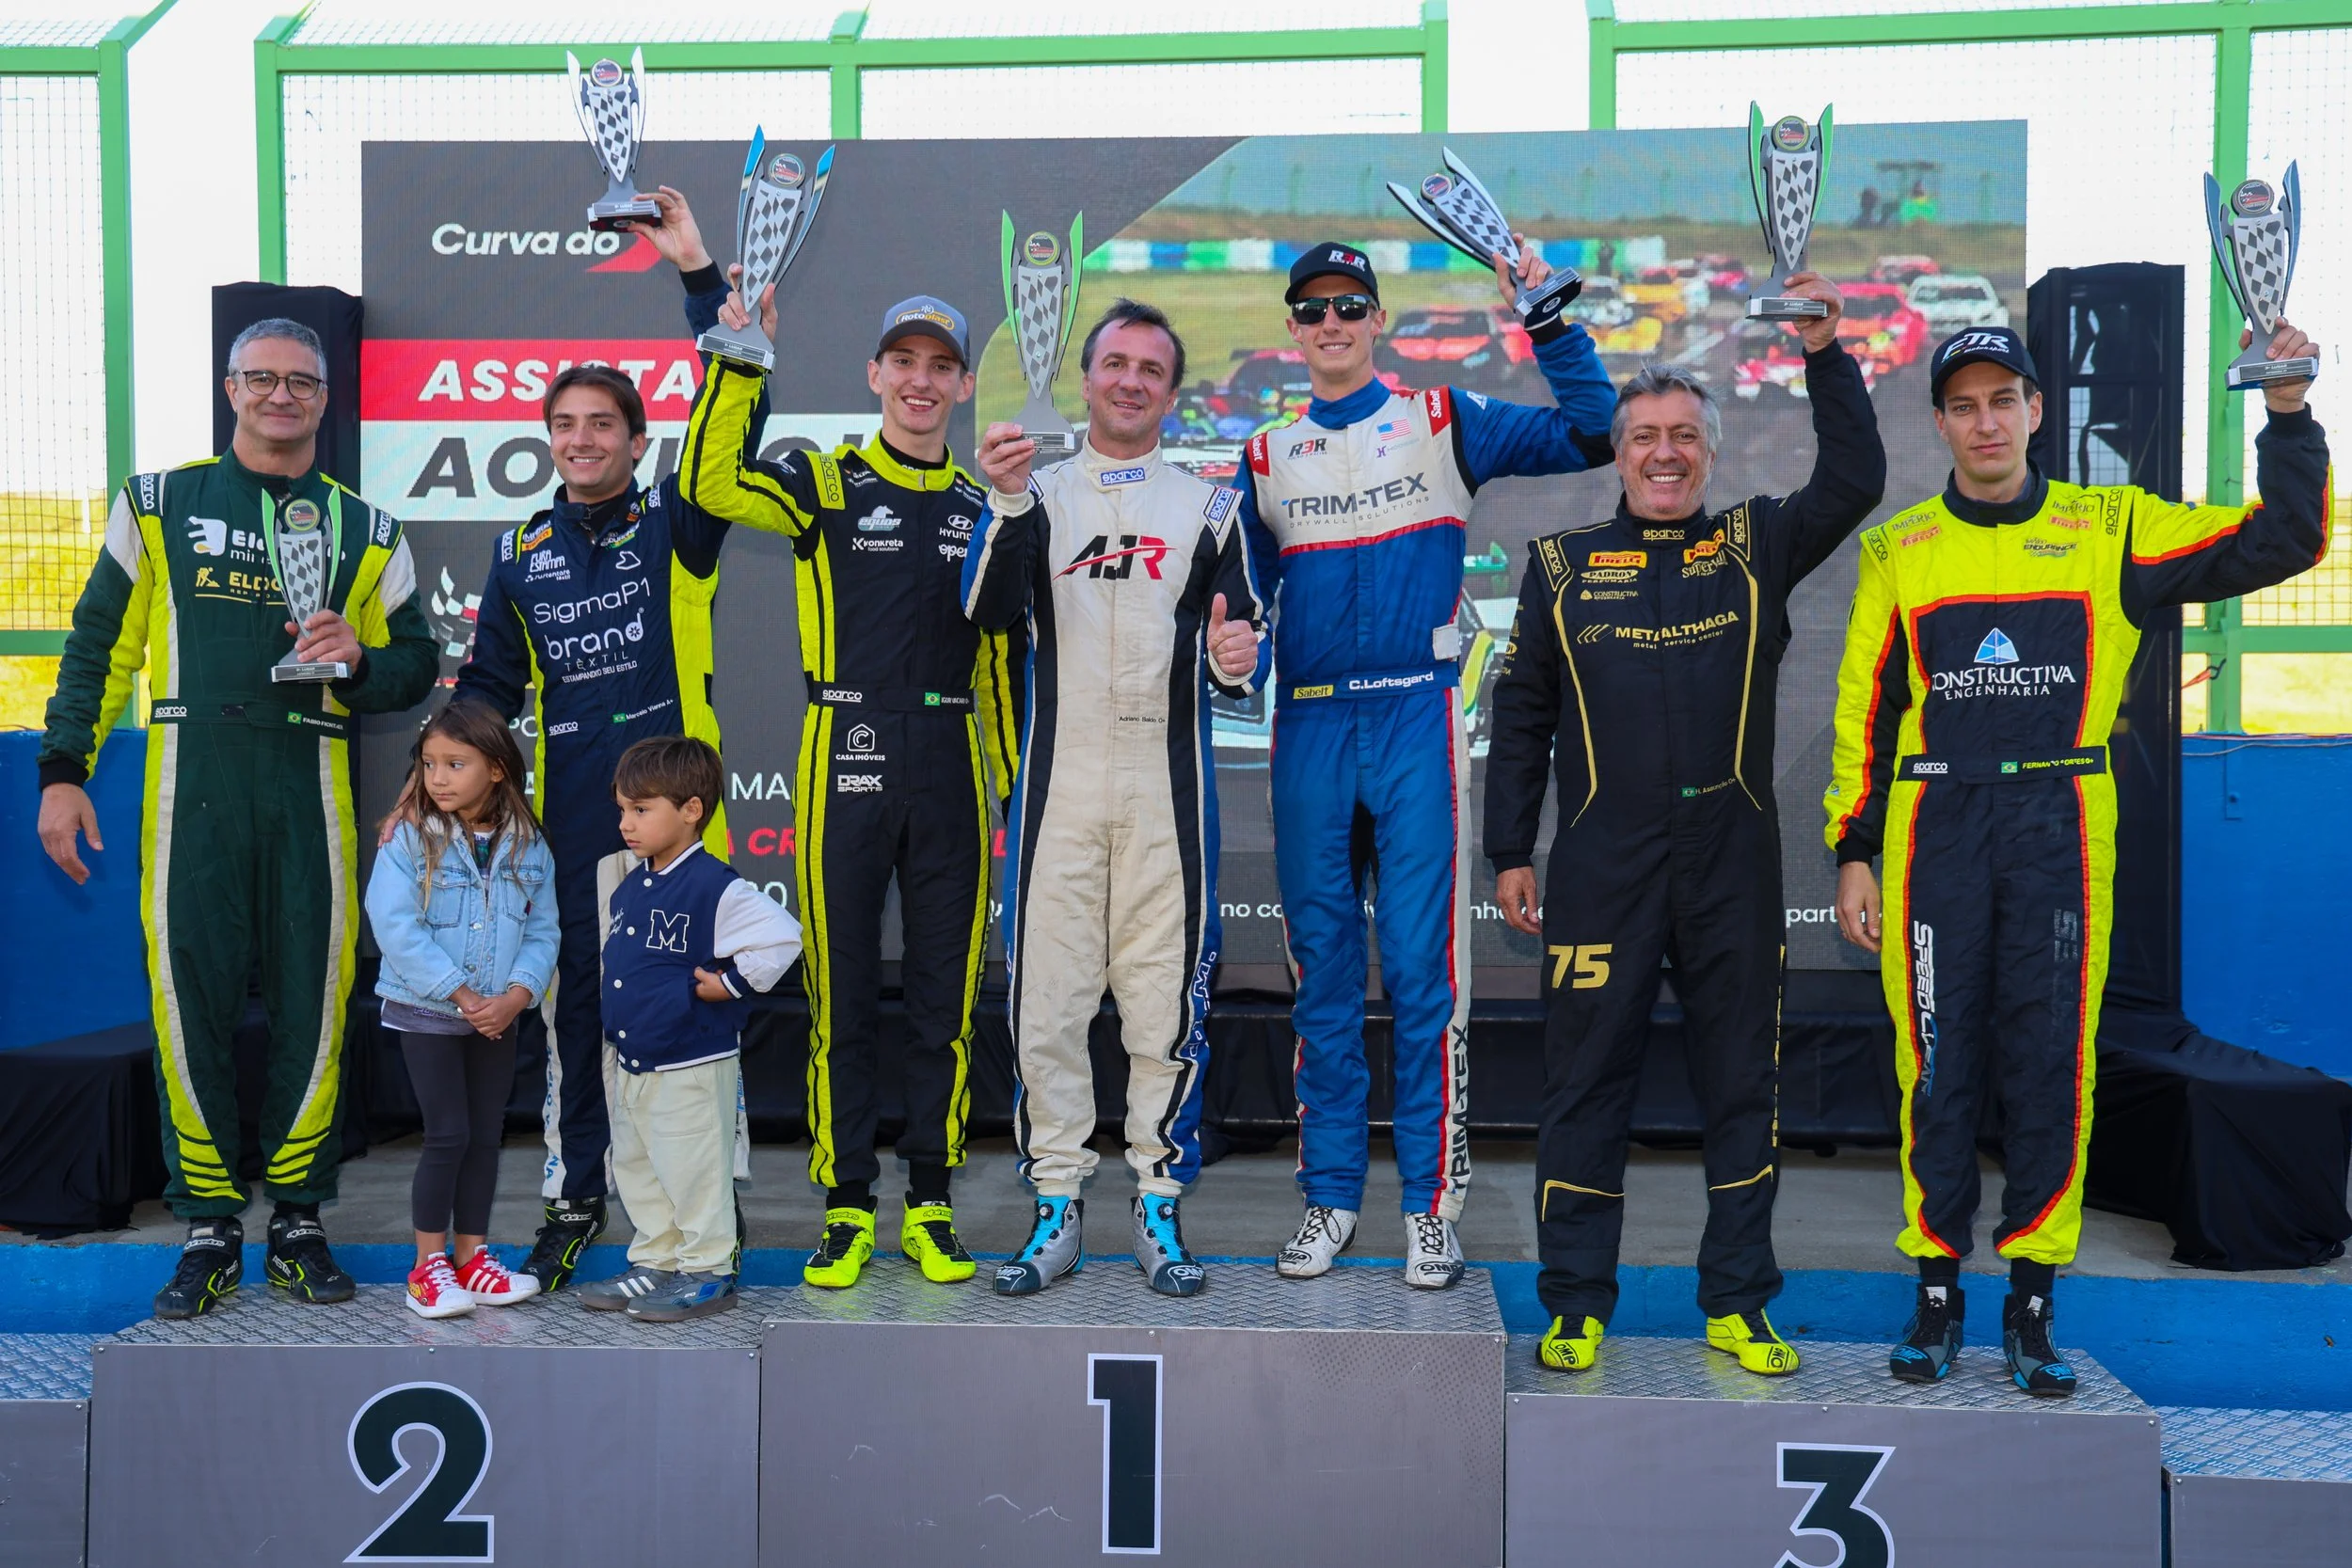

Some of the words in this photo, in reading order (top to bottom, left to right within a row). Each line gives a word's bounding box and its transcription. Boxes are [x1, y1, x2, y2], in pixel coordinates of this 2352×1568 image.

[431, 222, 559, 256] Curva
[564, 230, 620, 256] do
[418, 359, 697, 402] ASSTA
[1288, 437, 1327, 458] R3R
[1102, 468, 1145, 485] sparco
[1280, 471, 1428, 518] TRIM-TEX
[939, 527, 973, 542] HYUND
[1642, 528, 1686, 541] sparco
[1063, 534, 1168, 580] AJR
[1542, 538, 1564, 575] sparco
[533, 577, 651, 624] SigmaP1
[544, 612, 644, 660] brand
[602, 664, 616, 675] SEU
[616, 660, 638, 673] ESTILO
[822, 689, 863, 703] sparco
[1296, 686, 1329, 698] Sabelt
[1348, 671, 1435, 690] C.Loftsgard
[1944, 684, 2051, 701] ENGENHARIA
[155, 706, 187, 718] sparco
[548, 721, 579, 736] sparco
[854, 752, 886, 762] IMÓVEIS
[1913, 761, 1948, 774] sparco
[837, 774, 883, 786] DRAX
[646, 909, 691, 954] M
[1547, 942, 1613, 990] 75
[1554, 1343, 1578, 1366] OMP
[1087, 1353, 1165, 1558] 1
[344, 1378, 496, 1565] 2
[1774, 1441, 1897, 1568] 3
